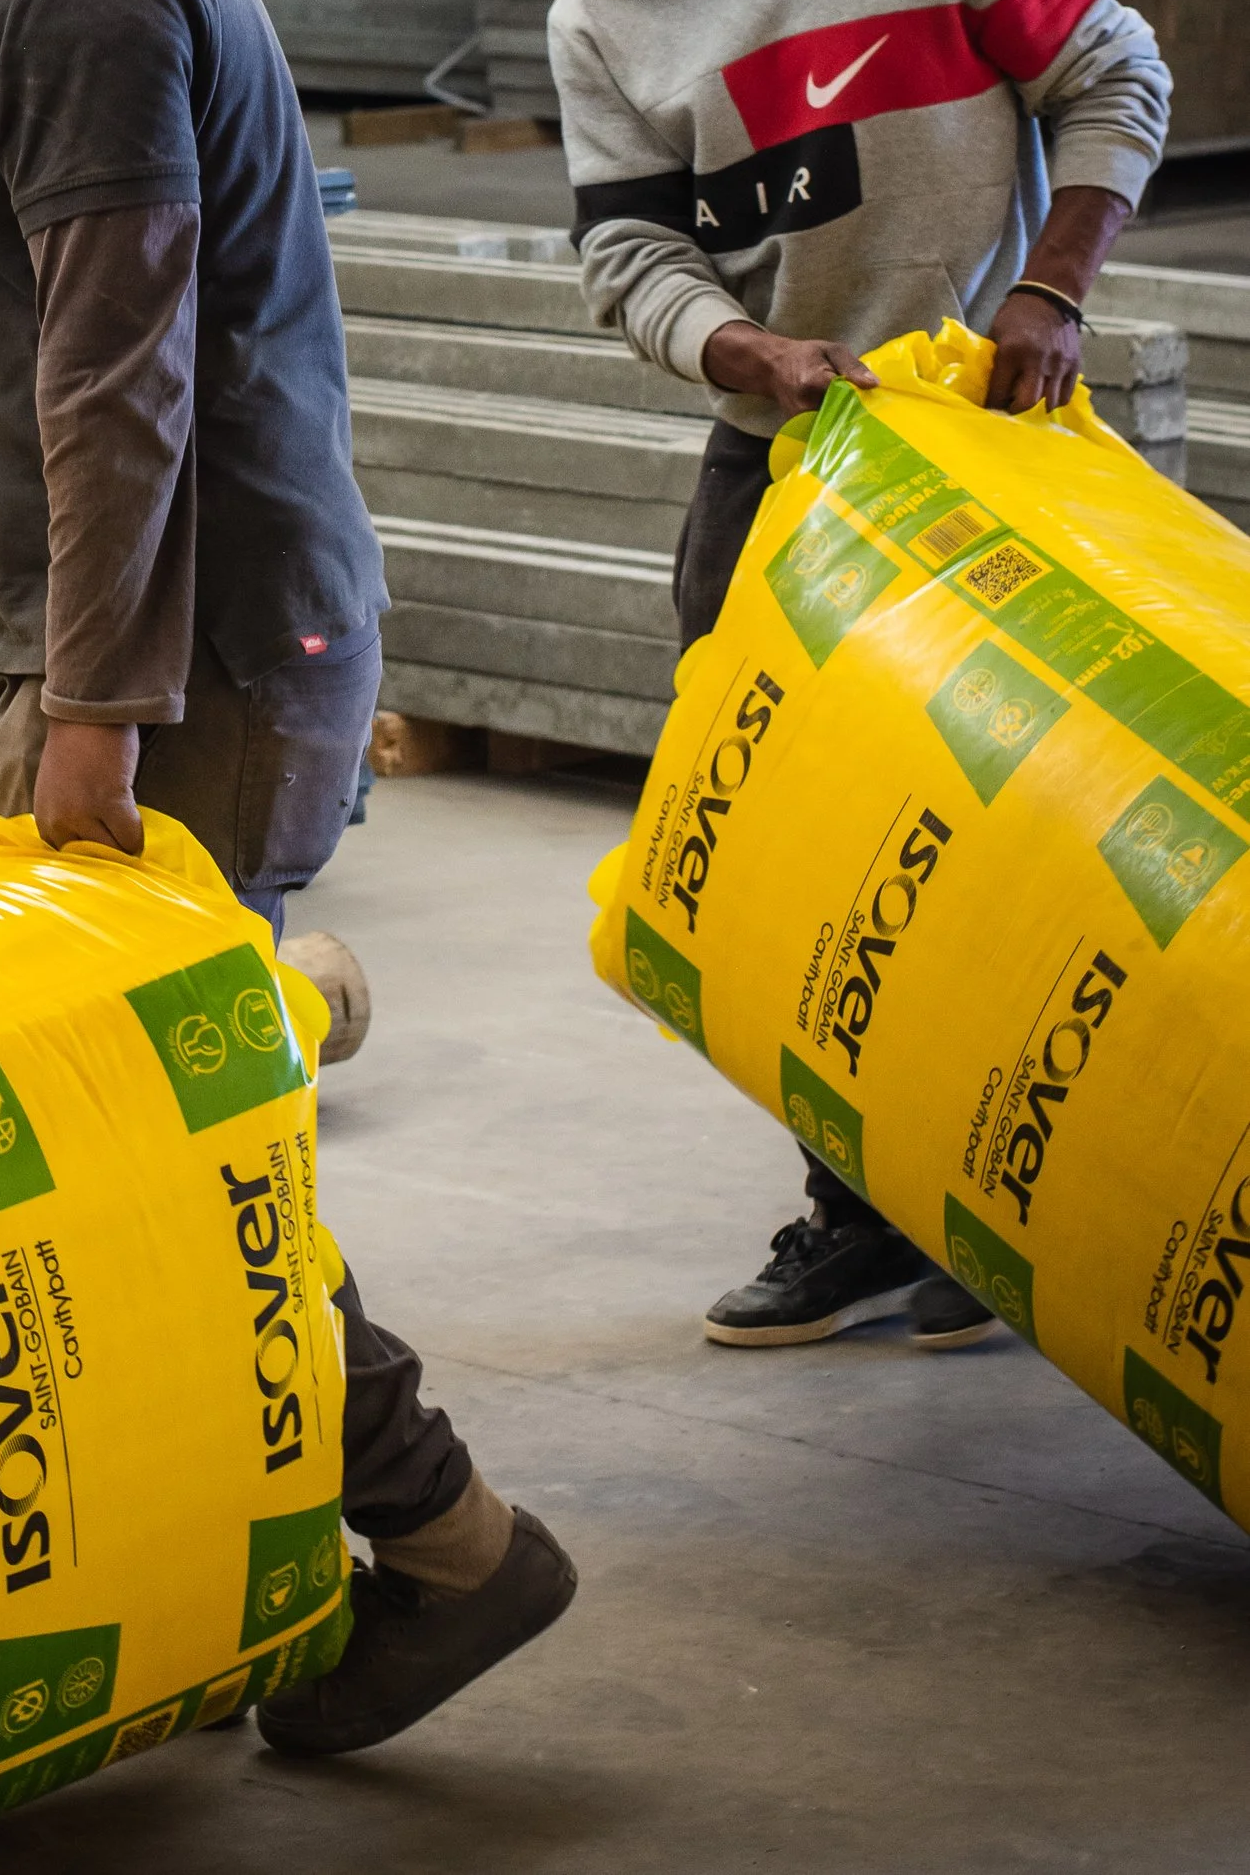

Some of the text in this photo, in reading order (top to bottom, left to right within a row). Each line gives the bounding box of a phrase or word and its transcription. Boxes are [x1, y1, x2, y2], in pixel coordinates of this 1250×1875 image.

[695, 166, 811, 227] AIR
[1073, 656, 1112, 687] mm
[1116, 632, 1155, 661] 102
[641, 783, 678, 892] Cavitybatt
[657, 771, 704, 909] SAINT-GOBAIN
[797, 921, 834, 1032] Cavitybatt
[816, 909, 865, 1051] SAINT-GOBAIN
[963, 1067, 1003, 1180] Cavitybatt
[984, 1054, 1037, 1199] SAINT-GOBAIN
[266, 1140, 304, 1315] SAINT-GOBAIN
[1167, 1208, 1224, 1356] SAINT-GOBAIN
[1, 1249, 58, 1431] SAINT-GOBAIN
[35, 1239, 84, 1380] Cavitybatt
